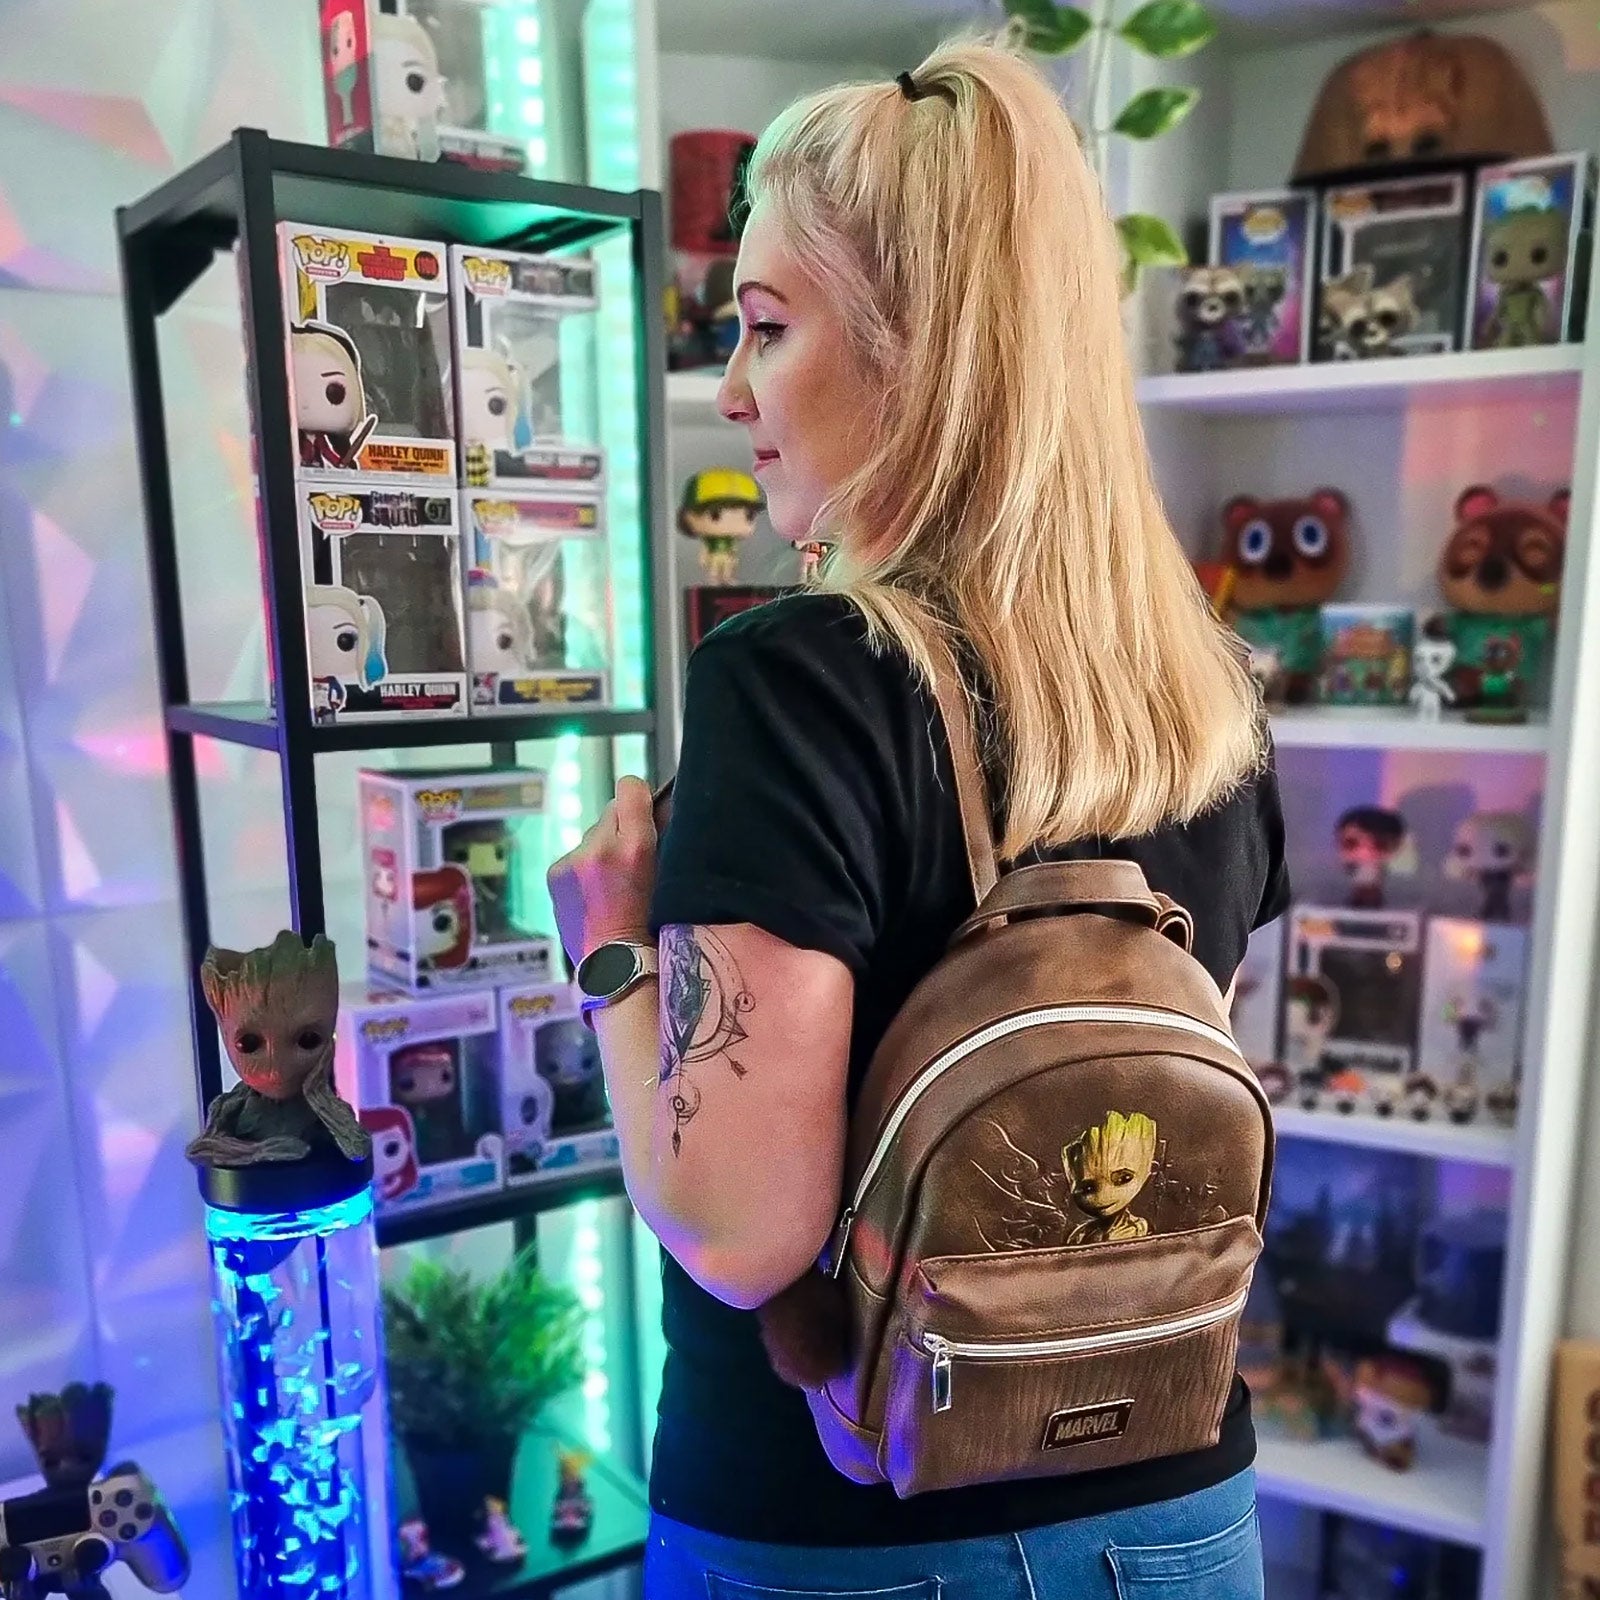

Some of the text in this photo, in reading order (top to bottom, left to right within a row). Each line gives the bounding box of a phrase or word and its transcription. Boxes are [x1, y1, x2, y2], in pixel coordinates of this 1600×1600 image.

[292, 234, 348, 267] POP!
[367, 444, 444, 461] HARLEY QUINN
[308, 494, 361, 522] POP!
[380, 682, 456, 698] HARLEY QUINN
[1055, 1411, 1120, 1441] MARVEL
